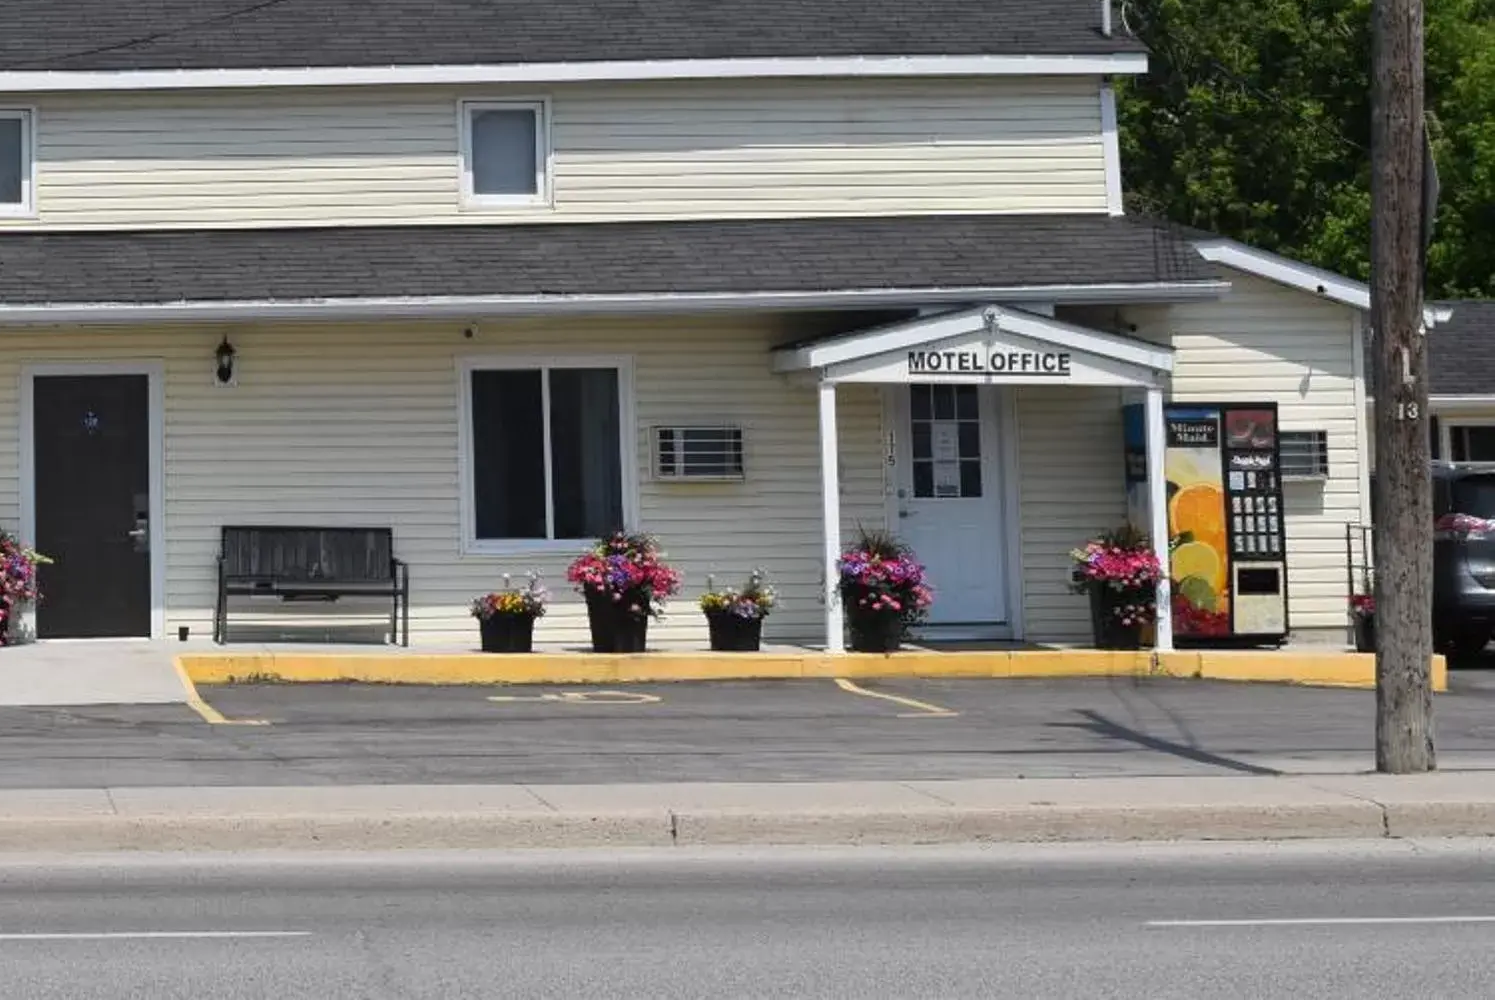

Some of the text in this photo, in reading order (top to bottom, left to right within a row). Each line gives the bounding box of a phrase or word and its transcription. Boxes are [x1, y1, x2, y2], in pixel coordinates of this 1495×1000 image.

[907, 351, 1071, 371] MOTEL OFFICE
[1398, 401, 1419, 420] 13
